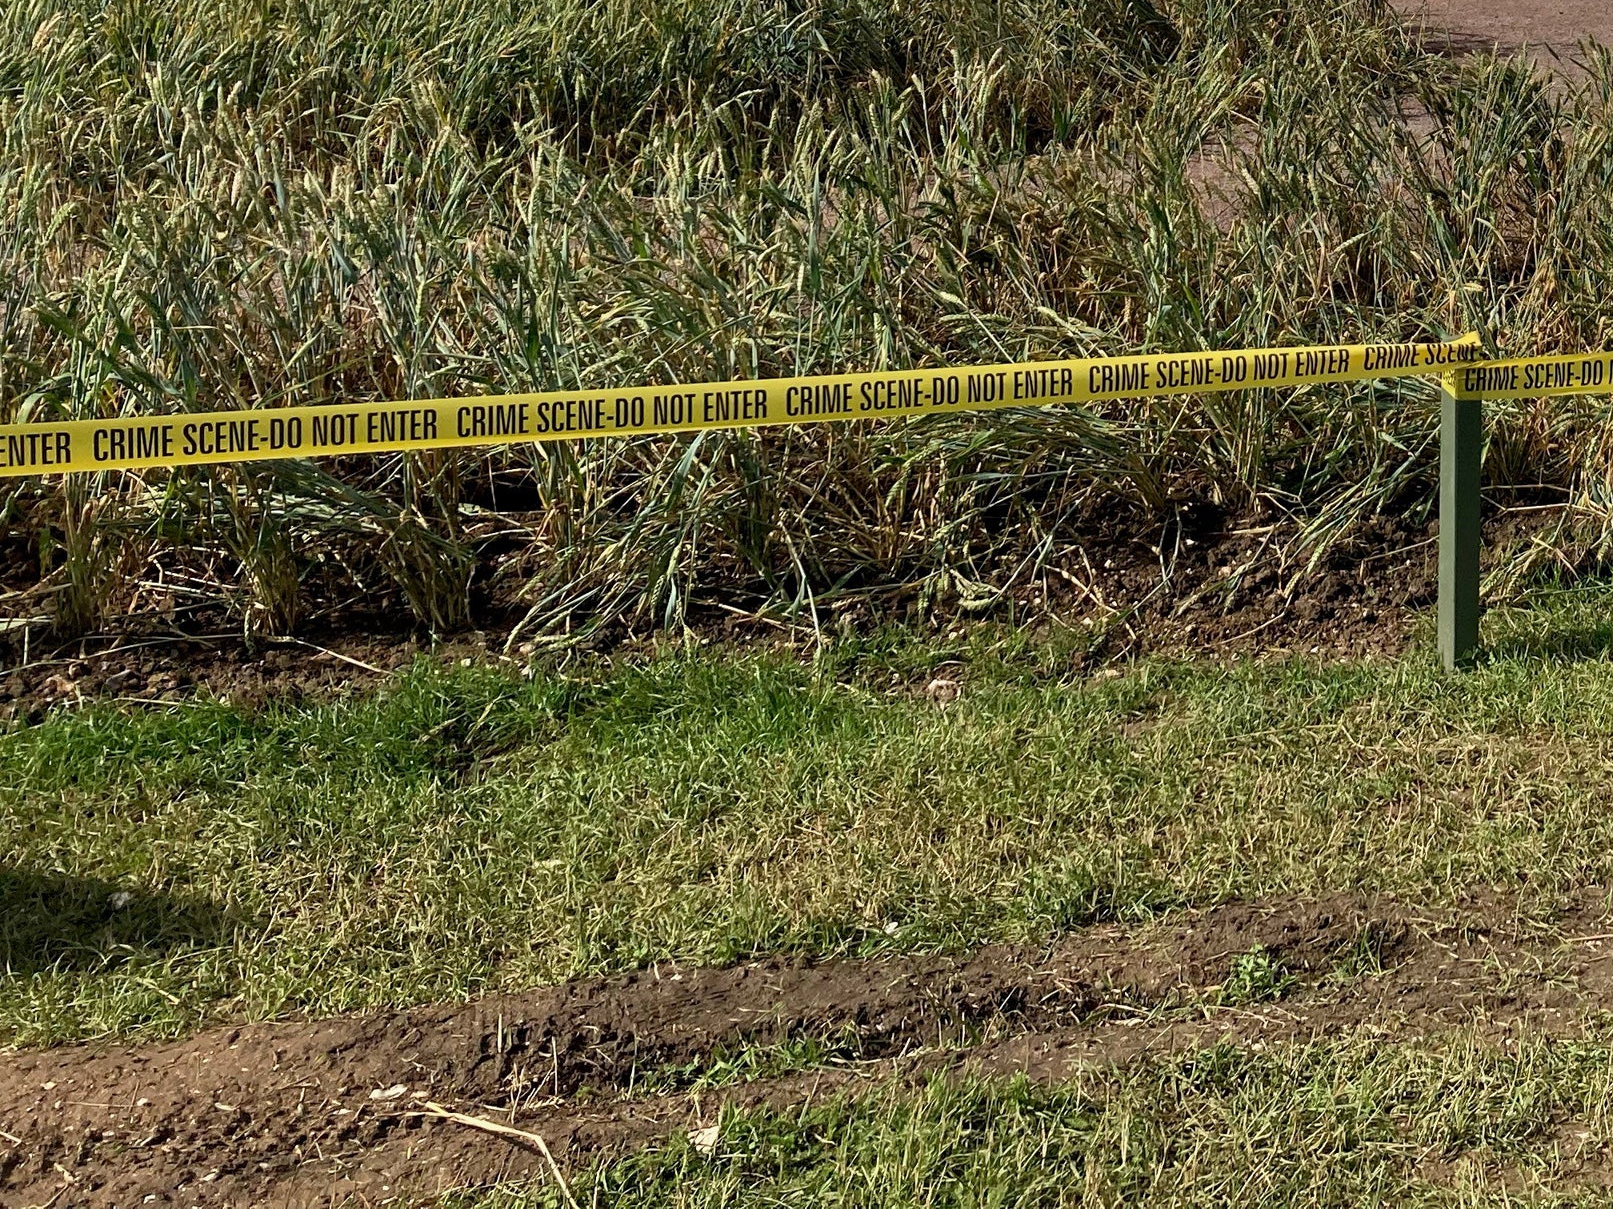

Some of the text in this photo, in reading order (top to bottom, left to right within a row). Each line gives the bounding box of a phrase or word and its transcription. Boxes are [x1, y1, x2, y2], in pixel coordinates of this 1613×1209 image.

[93, 424, 174, 462] CRIME
[182, 416, 302, 456] SCENE-DO
[312, 412, 359, 447] NOT
[367, 408, 437, 442] ENTER
[457, 403, 529, 438] CRIME
[537, 396, 645, 431] SCENE-DO
[653, 393, 696, 426] NOT
[703, 388, 767, 422] ENTER
[785, 383, 853, 417] CRIME
[860, 375, 959, 411] SCENE-DO
[968, 372, 1008, 403] NOT
[1013, 367, 1073, 399] ENTER
[1088, 362, 1150, 394] CRIME
[1156, 355, 1247, 389] SCENE-DO
[1253, 352, 1290, 380] NOT
[1295, 347, 1350, 376] ENTER
[1363, 343, 1420, 371] CRIME
[1464, 365, 1519, 392] CRIME
[1523, 359, 1602, 390] SCENE-DO
